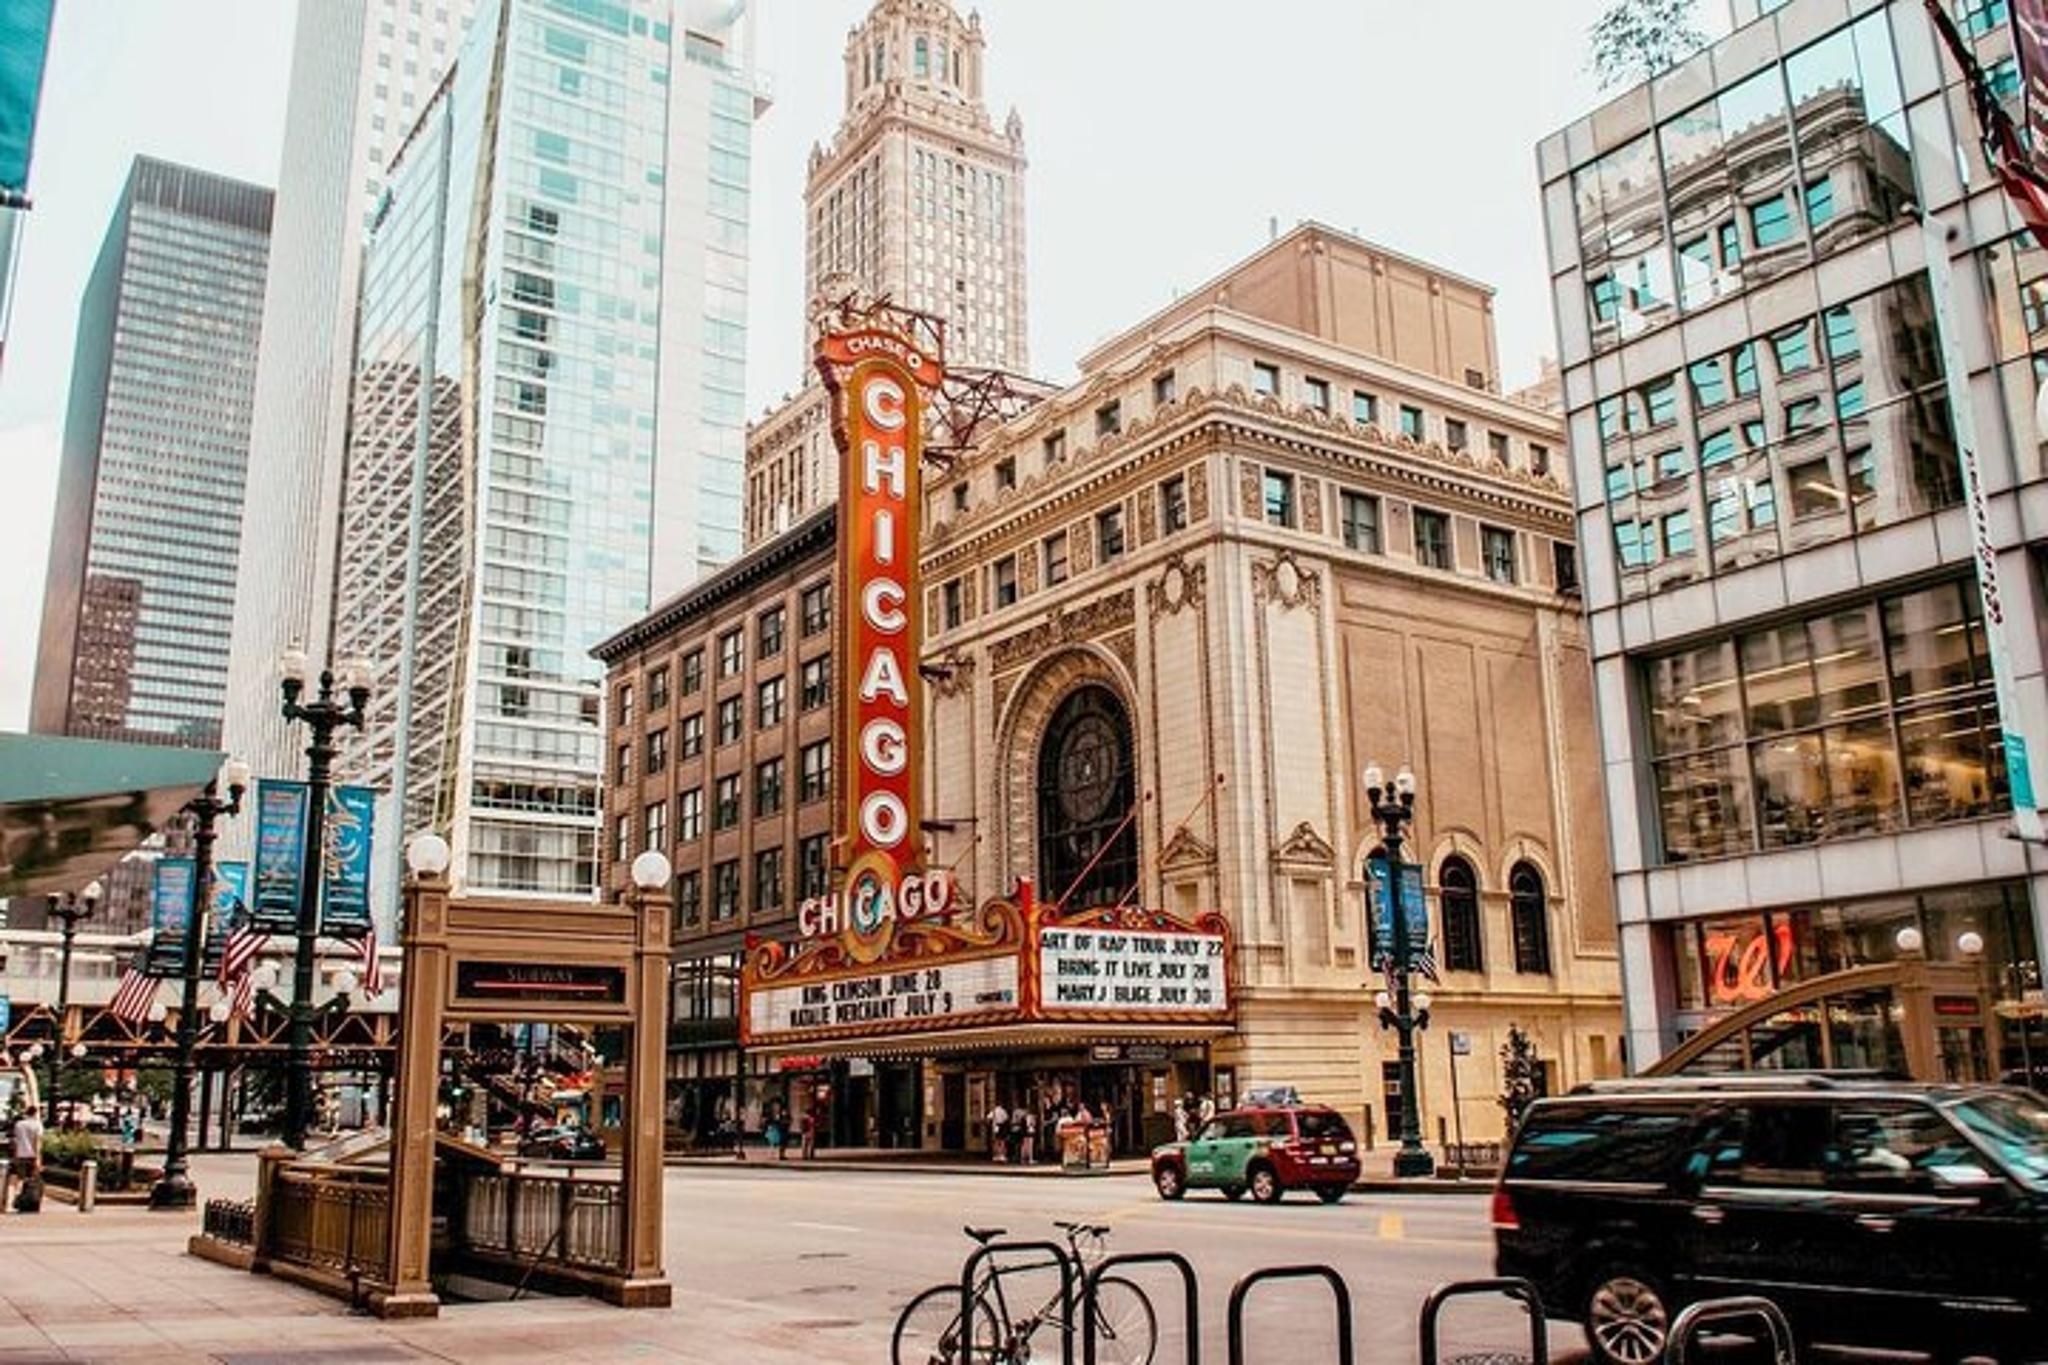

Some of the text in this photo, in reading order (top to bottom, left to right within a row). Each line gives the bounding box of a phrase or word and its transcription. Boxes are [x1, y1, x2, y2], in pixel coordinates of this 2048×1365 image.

[859, 378, 908, 848] CHICAGO
[800, 869, 948, 936] CHICAGO
[1041, 932, 1068, 949] ART
[1074, 935, 1092, 950] OF
[1100, 936, 1127, 951] RAP
[1132, 938, 1167, 954] TOUR
[1171, 940, 1200, 955] JULY
[507, 967, 574, 982] SUBWAY
[1057, 958, 1100, 976] BRING
[1106, 961, 1118, 976] IT
[1123, 961, 1152, 978] LIVE
[1157, 962, 1187, 979] JULY
[802, 984, 827, 1004] KING
[833, 977, 882, 1001] CRIMSON
[888, 972, 918, 995] JUNE
[1057, 983, 1096, 1001] MARY
[1099, 986, 1107, 1001] J
[1115, 986, 1152, 1003] BLIGE
[1157, 987, 1187, 1003] JULY
[790, 992, 952, 1027] NATALIE MERCHANT JULY 9
